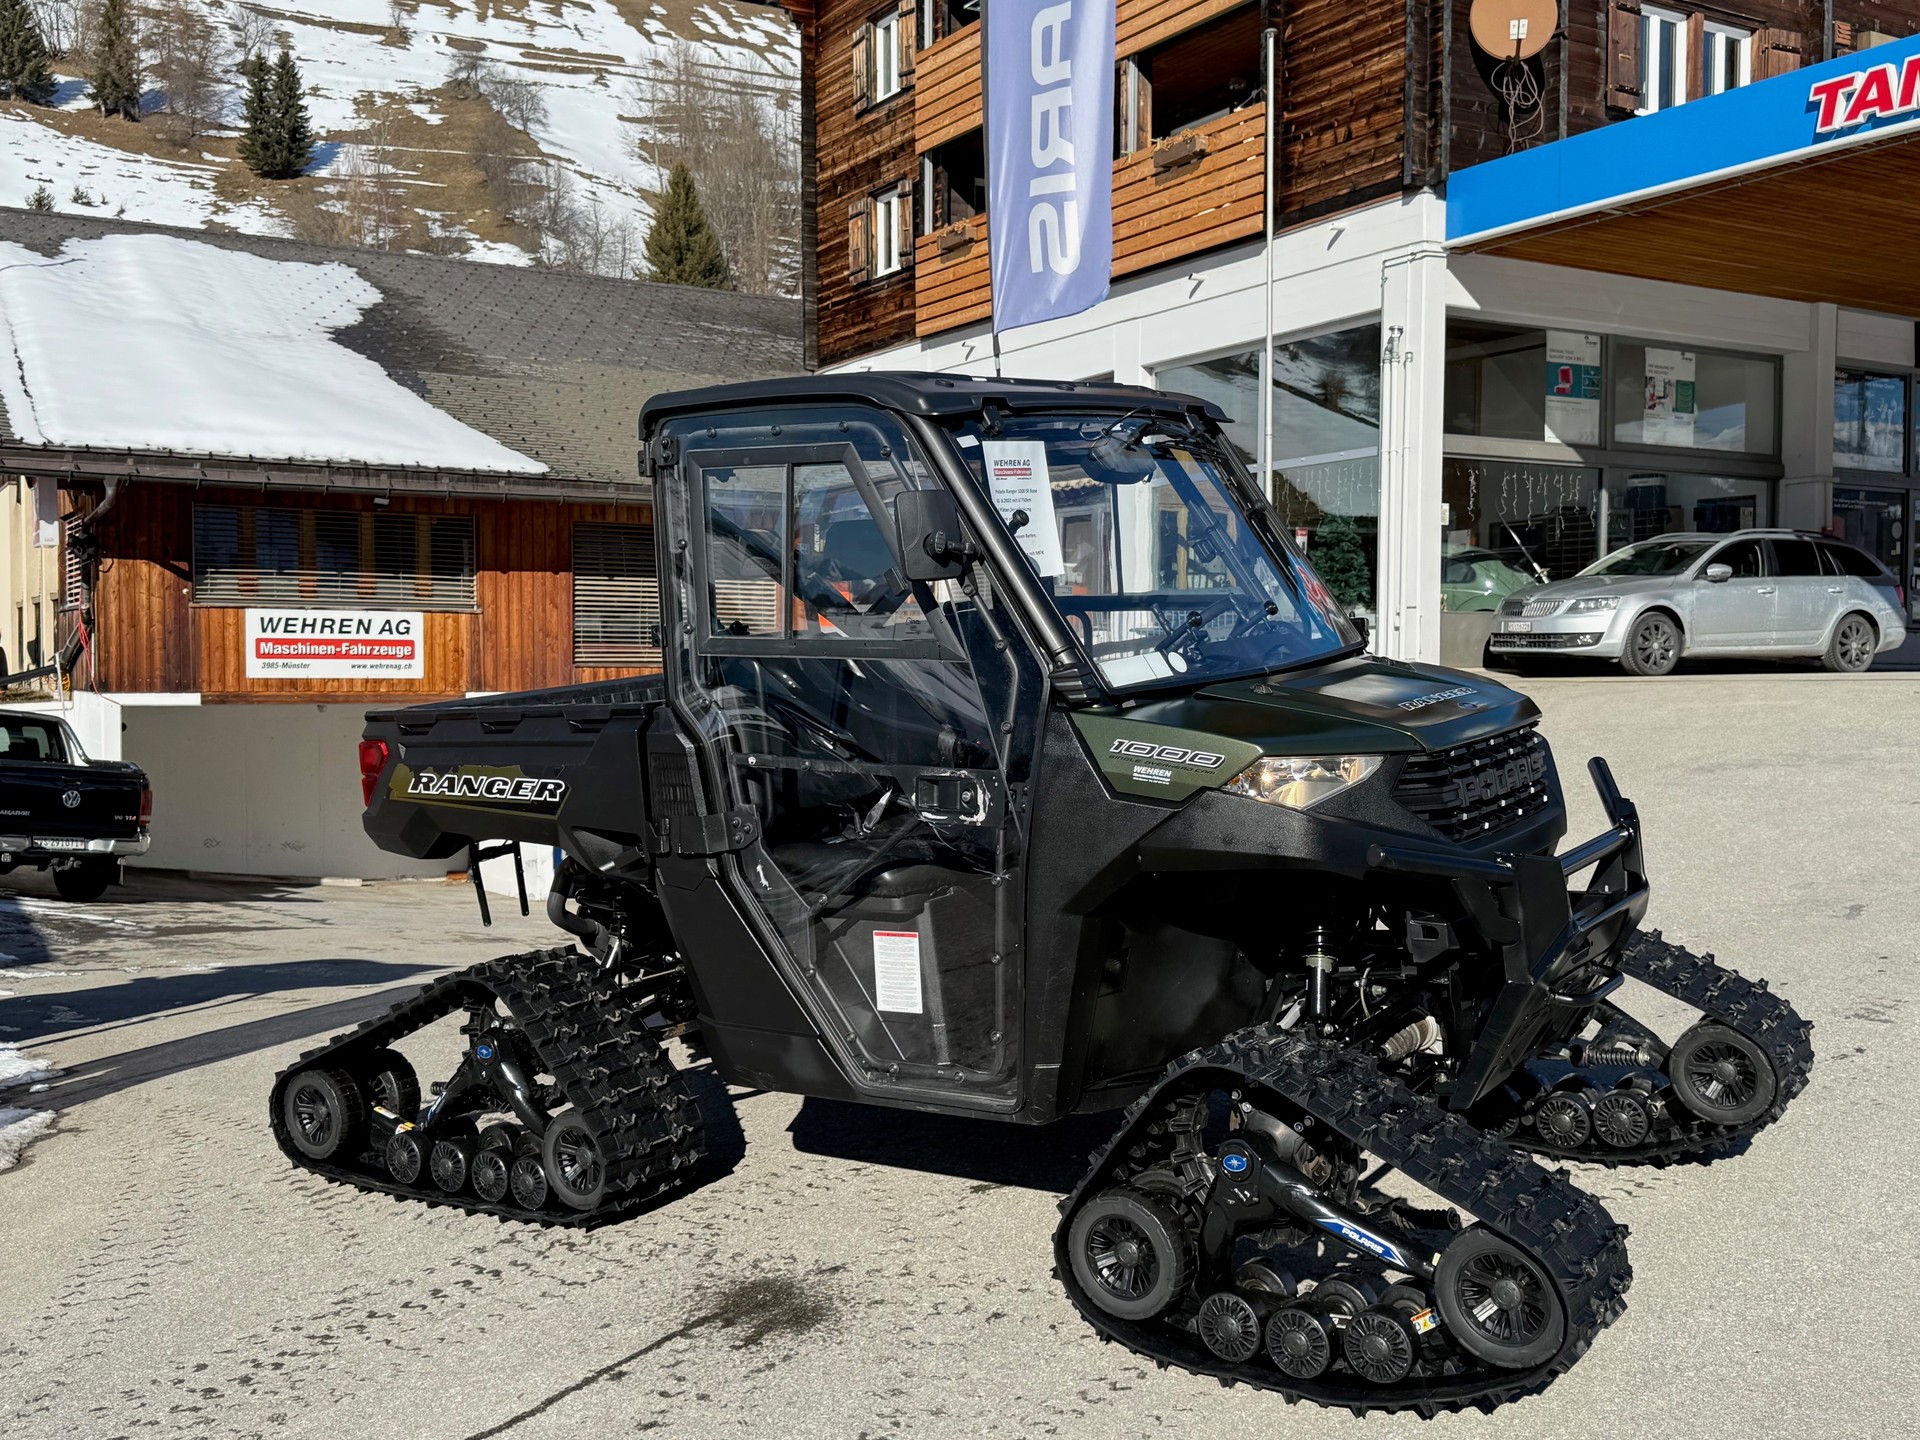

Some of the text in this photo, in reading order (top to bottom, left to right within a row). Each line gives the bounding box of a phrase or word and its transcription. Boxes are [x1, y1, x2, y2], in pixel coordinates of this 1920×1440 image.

[994, 459, 1021, 467] WEHREN
[260, 616, 411, 635] WEHREN AG
[259, 641, 413, 659] Maschinen-Fahrzeuge
[261, 661, 413, 672] 3985-Münster www.wehrenag.ch
[1397, 687, 1478, 711] RANGER
[1109, 738, 1226, 769] 1000
[1108, 754, 1217, 777] SINGLE OVERHEAD CAM
[1133, 765, 1173, 778] WEHREN
[407, 772, 566, 802] RANGER
[1341, 1226, 1386, 1255] POLARIS
